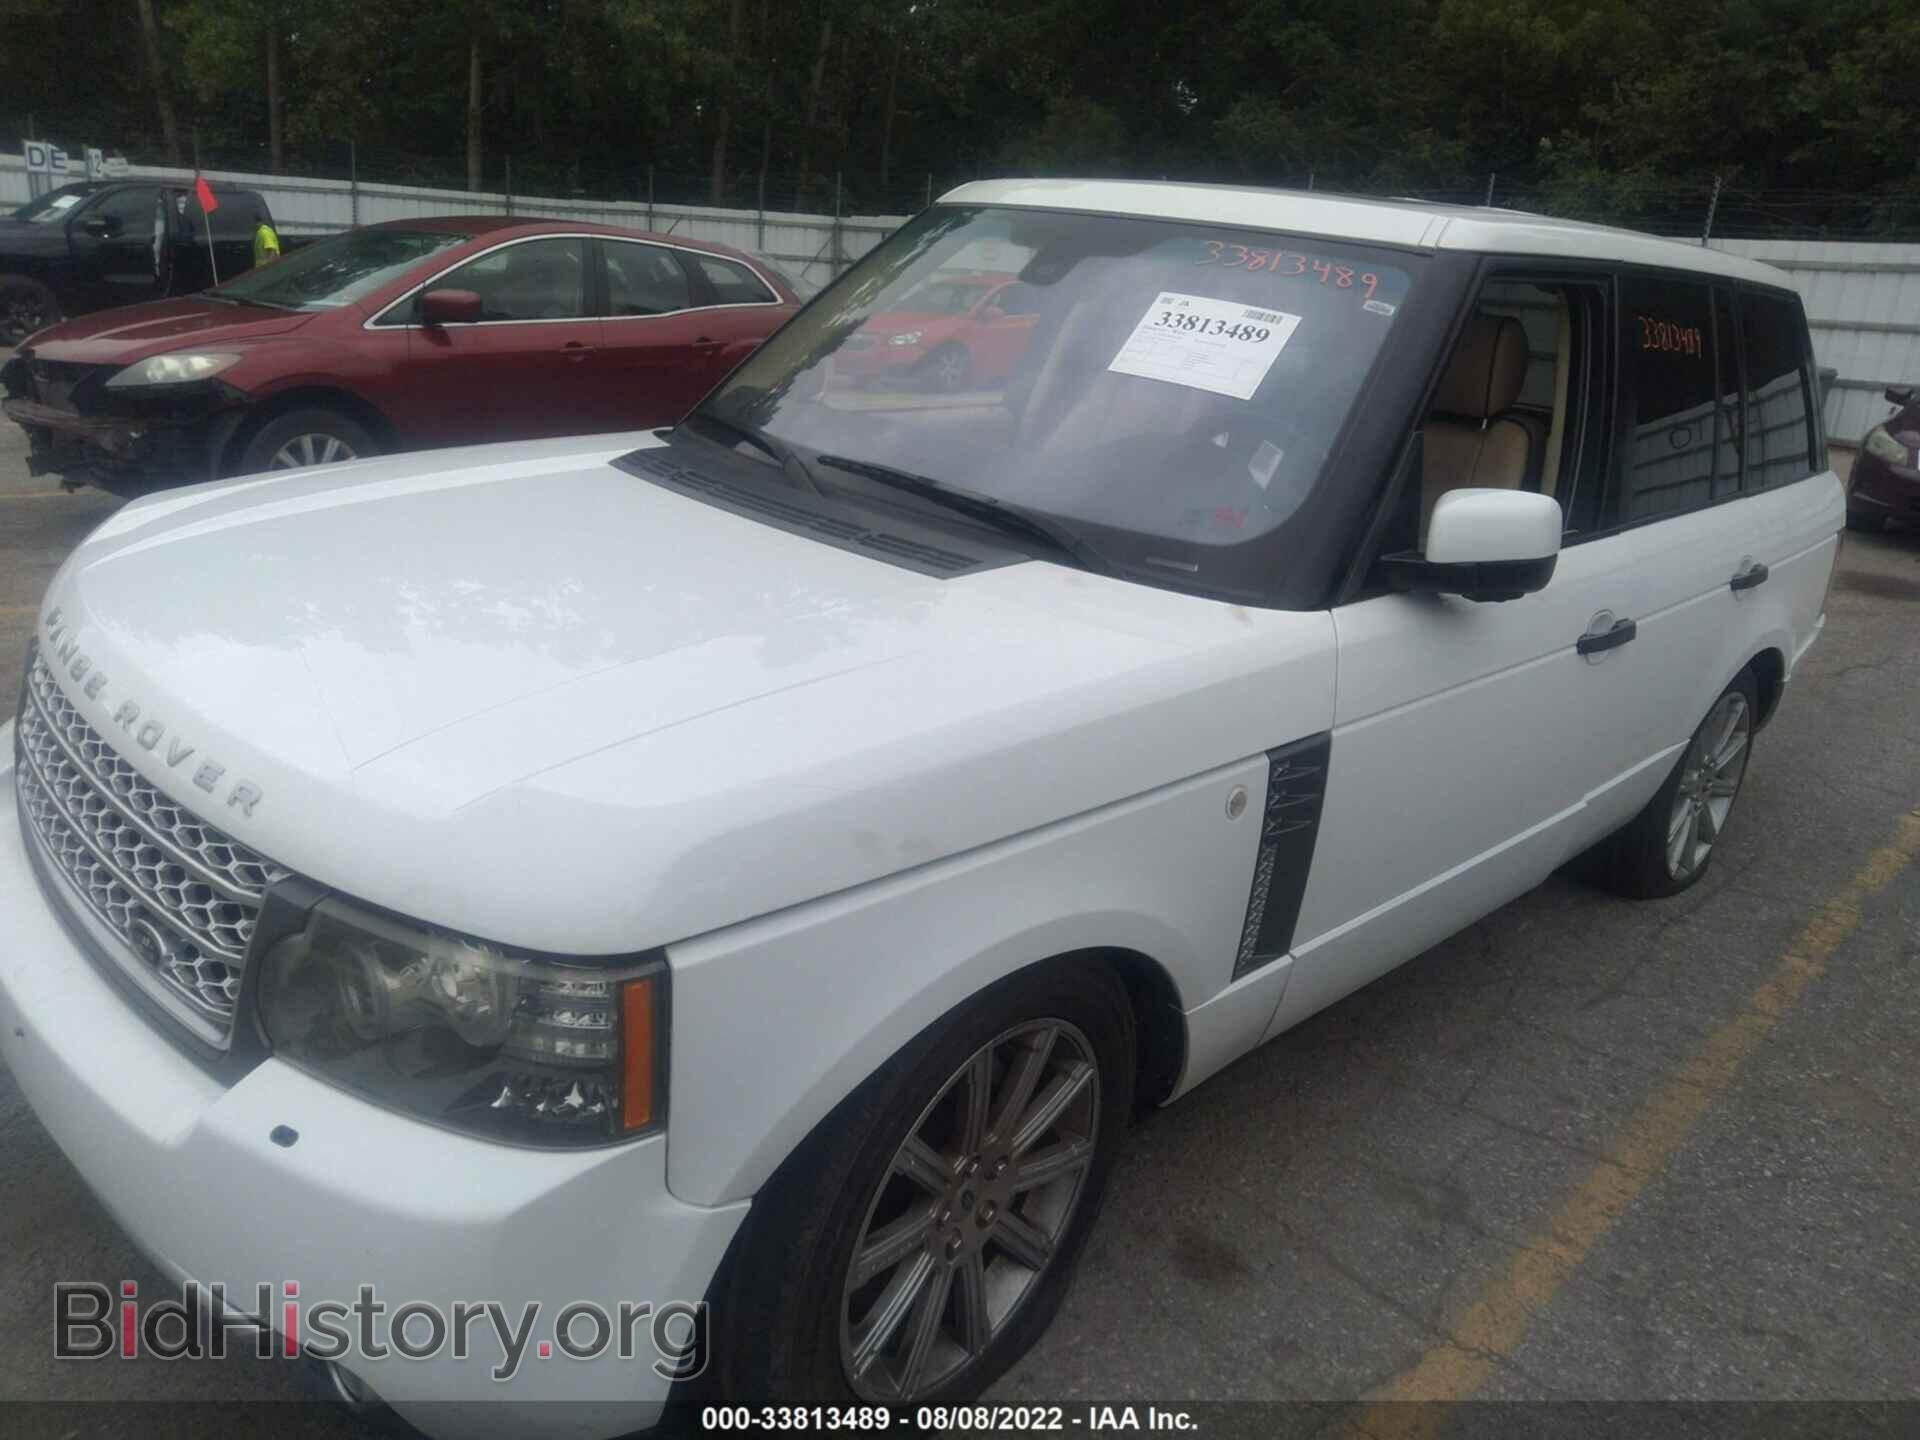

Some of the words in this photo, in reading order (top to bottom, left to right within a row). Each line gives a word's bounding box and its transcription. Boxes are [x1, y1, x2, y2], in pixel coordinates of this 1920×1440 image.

[1196, 240, 1378, 302] 33813489
[1153, 310, 1271, 345] 33813489
[113, 699, 263, 817] ROVER
